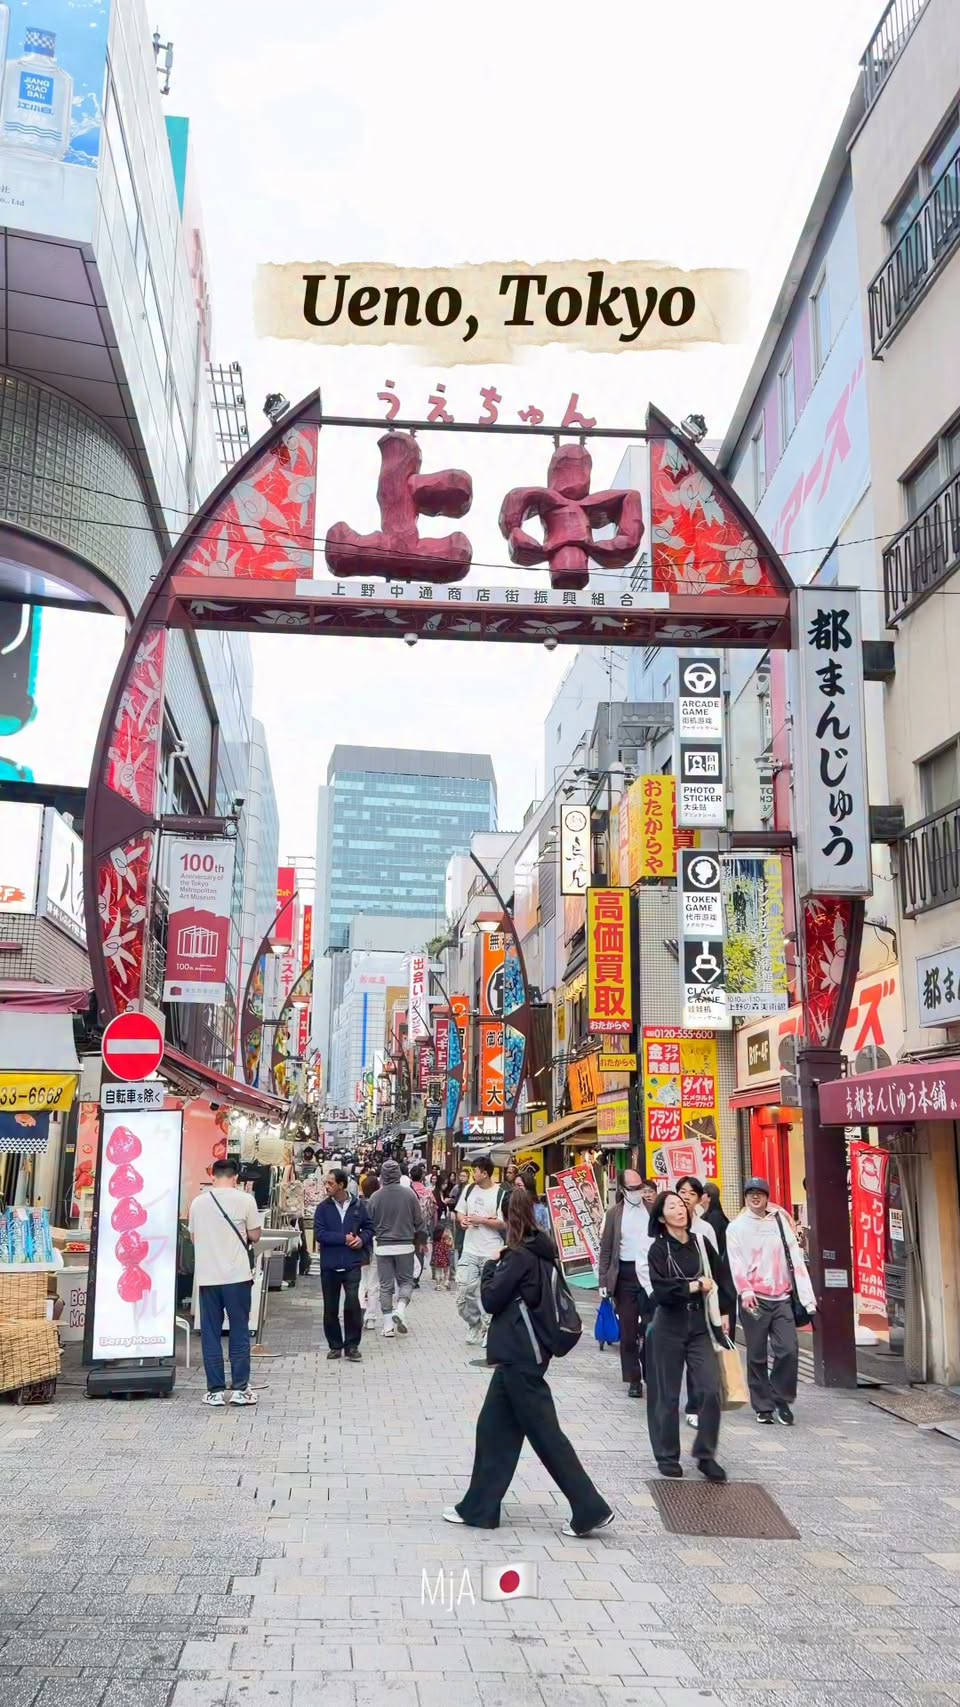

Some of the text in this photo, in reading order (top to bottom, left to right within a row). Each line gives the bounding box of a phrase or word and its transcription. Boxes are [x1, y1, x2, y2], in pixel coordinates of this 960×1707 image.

[24, 76, 50, 88] JIANG
[25, 83, 48, 94] XIAO
[325, 431, 645, 589] 上中
[331, 582, 634, 607] 上野中通商店街振興組合
[682, 700, 720, 708] ARCADE
[682, 708, 709, 716] GAME
[807, 608, 853, 867] 都まんじゅう
[683, 786, 715, 794] PHOTO
[644, 778, 664, 874] おたからや
[180, 873, 216, 881] Anniversary
[191, 880, 209, 888] Tokyo
[180, 887, 217, 895] Metropolitan
[685, 895, 718, 903] TOKEN
[685, 904, 713, 912] GAME
[593, 890, 626, 1017] 高価買取
[590, 1020, 630, 1031] おたからや
[648, 1043, 663, 1060] 金
[600, 1058, 636, 1068] おたからや
[682, 1077, 714, 1095] ダイヤ
[105, 1088, 161, 1105] 自転車を除く
[649, 1110, 681, 1125] ブランド
[650, 1126, 681, 1141] バッグ
